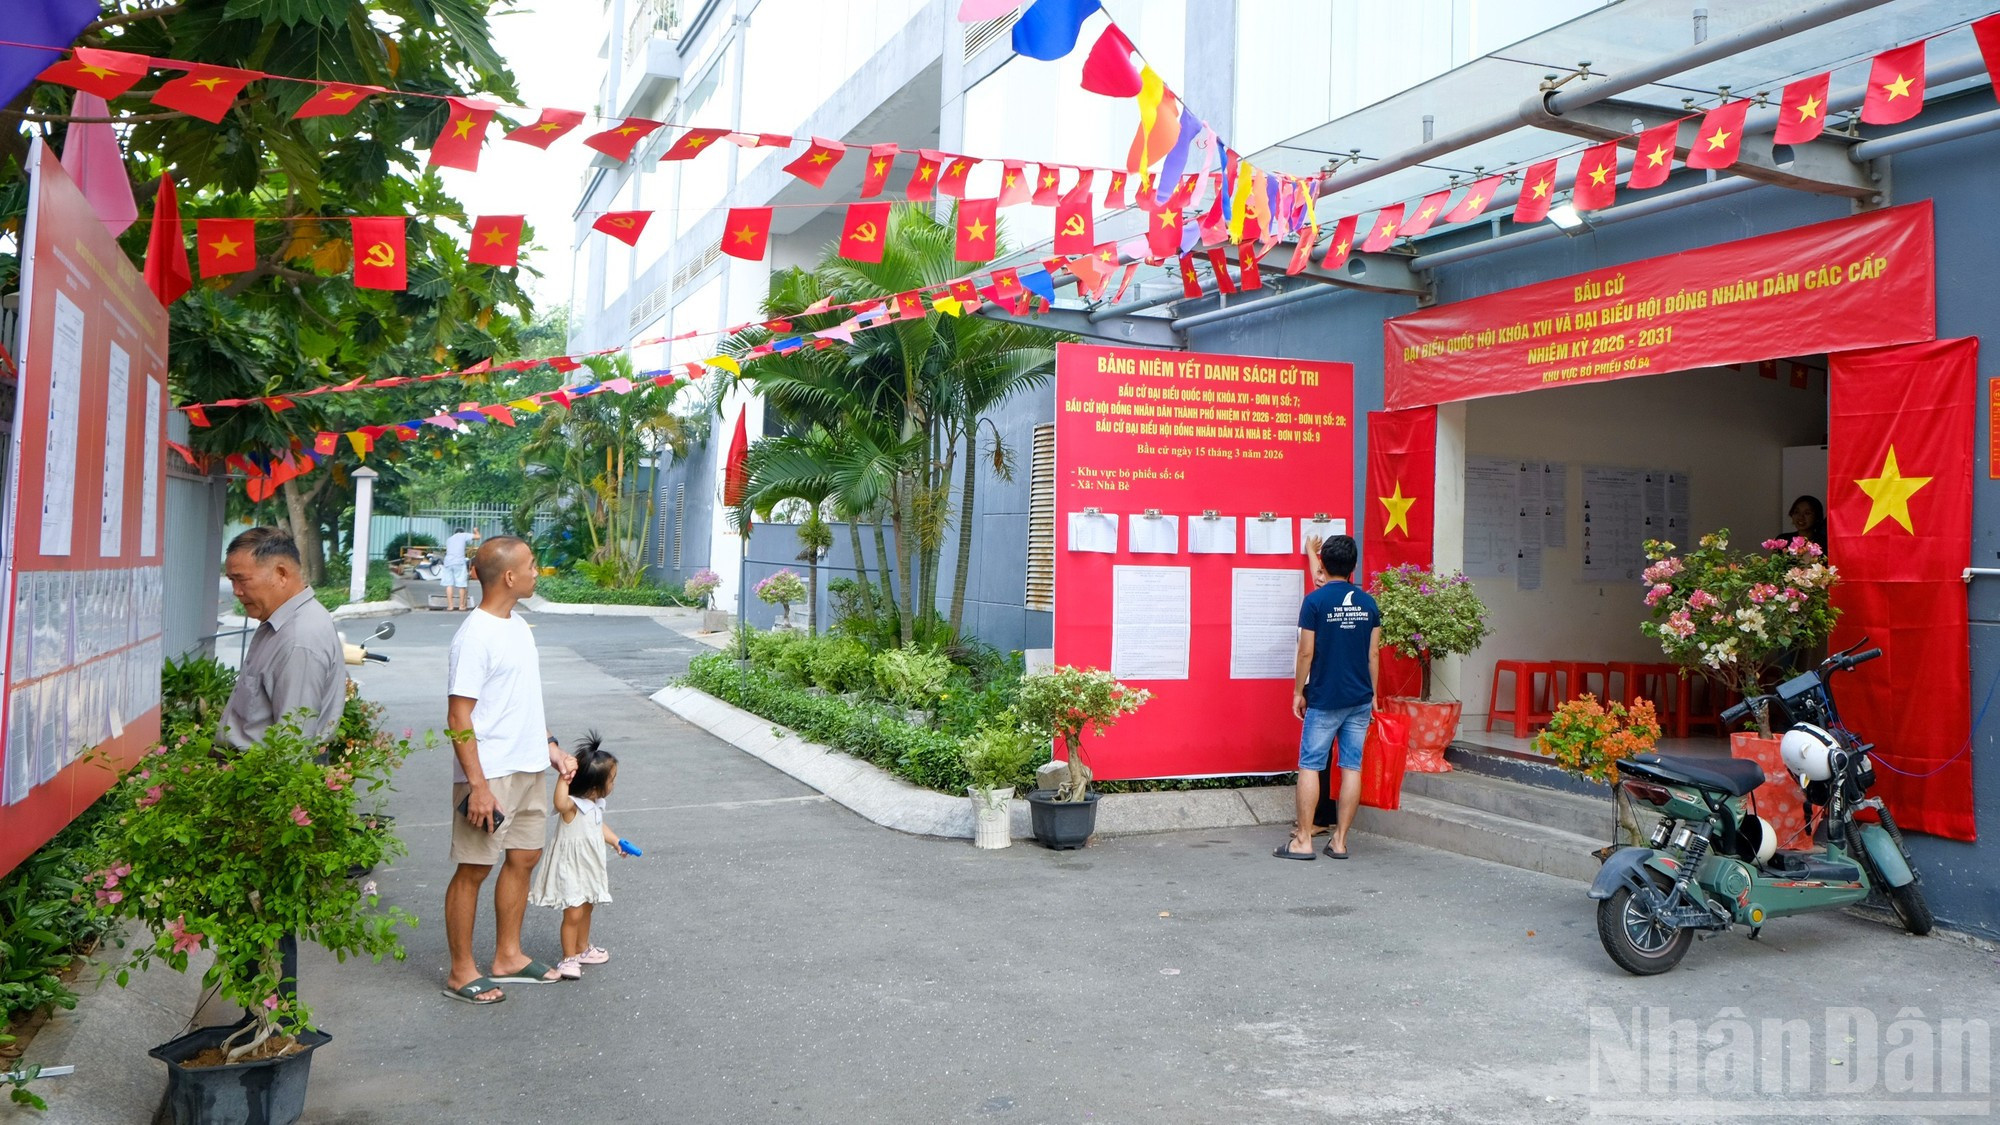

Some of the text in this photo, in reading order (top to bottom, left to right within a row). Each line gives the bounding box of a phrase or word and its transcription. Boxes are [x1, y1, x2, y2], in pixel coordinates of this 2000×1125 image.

[1575, 273, 1625, 303] BẦU CỬ
[1404, 345, 1419, 363] ĐẠI
[1448, 330, 1474, 354] QUỐC
[1478, 328, 1495, 349] HỘI
[1498, 323, 1529, 343] KHÓA
[1533, 319, 1552, 337] XVI
[1556, 313, 1572, 333] VÀ
[1575, 311, 1597, 332] ĐẠI
[1602, 299, 1632, 325] BIỂU
[1637, 296, 1660, 321] HỘI
[1666, 288, 1707, 314] ĐỒNG
[1712, 279, 1758, 306] NHÂN
[1763, 272, 1799, 297] DÂN
[1805, 264, 1842, 289] CÁC
[1848, 253, 1887, 282] CẤP
[1528, 342, 1568, 365] NHIỆM
[1572, 337, 1589, 357] KỲ
[1592, 334, 1625, 354] 2026
[1638, 326, 1672, 347] 2031
[1098, 353, 1319, 386] BẢNG NIÊM YẾT DANH SÁCH CỬ TRI
[1542, 355, 1650, 382] KHU VỰC BỎ PHIẾU SỐ 64
[1138, 442, 1155, 454] Bầu
[1158, 446, 1169, 454] cử
[1172, 447, 1192, 457] ngày
[1195, 447, 1205, 455] 15
[1208, 448, 1232, 458] tháng
[1242, 450, 1261, 458] năm
[1264, 450, 1283, 459] 2026
[1078, 467, 1098, 476] Khu
[1100, 469, 1116, 479] vực
[1119, 468, 1130, 478] bỏ
[1132, 468, 1156, 480] phiếu
[1159, 468, 1172, 479] số:
[1174, 471, 1184, 479] 64
[1078, 480, 1094, 489] Xã:
[1097, 481, 1115, 490] Nhà
[1118, 481, 1130, 490] Bè
